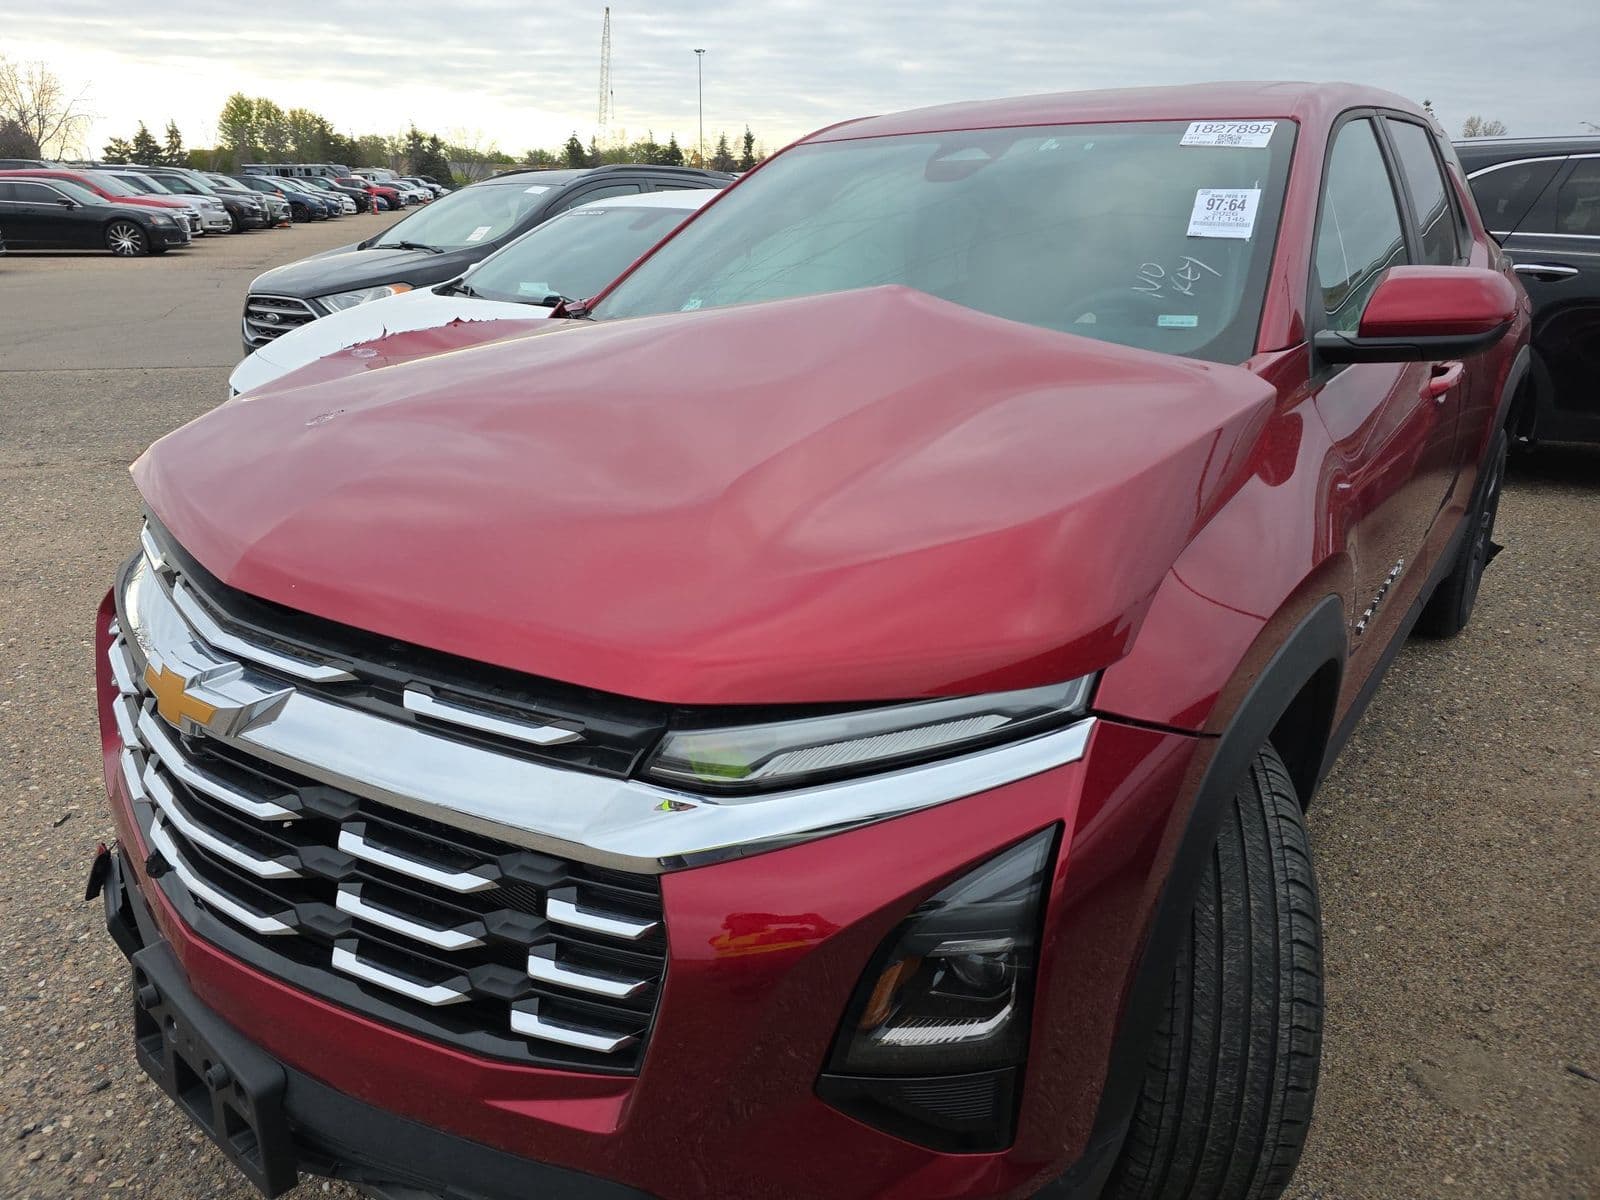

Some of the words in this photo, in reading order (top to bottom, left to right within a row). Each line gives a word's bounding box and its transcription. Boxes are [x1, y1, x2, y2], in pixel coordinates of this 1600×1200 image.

[1193, 124, 1273, 134] 1827895
[1206, 198, 1248, 212] 97:64
[1130, 262, 1166, 298] NO
[1171, 255, 1223, 297] KEY
